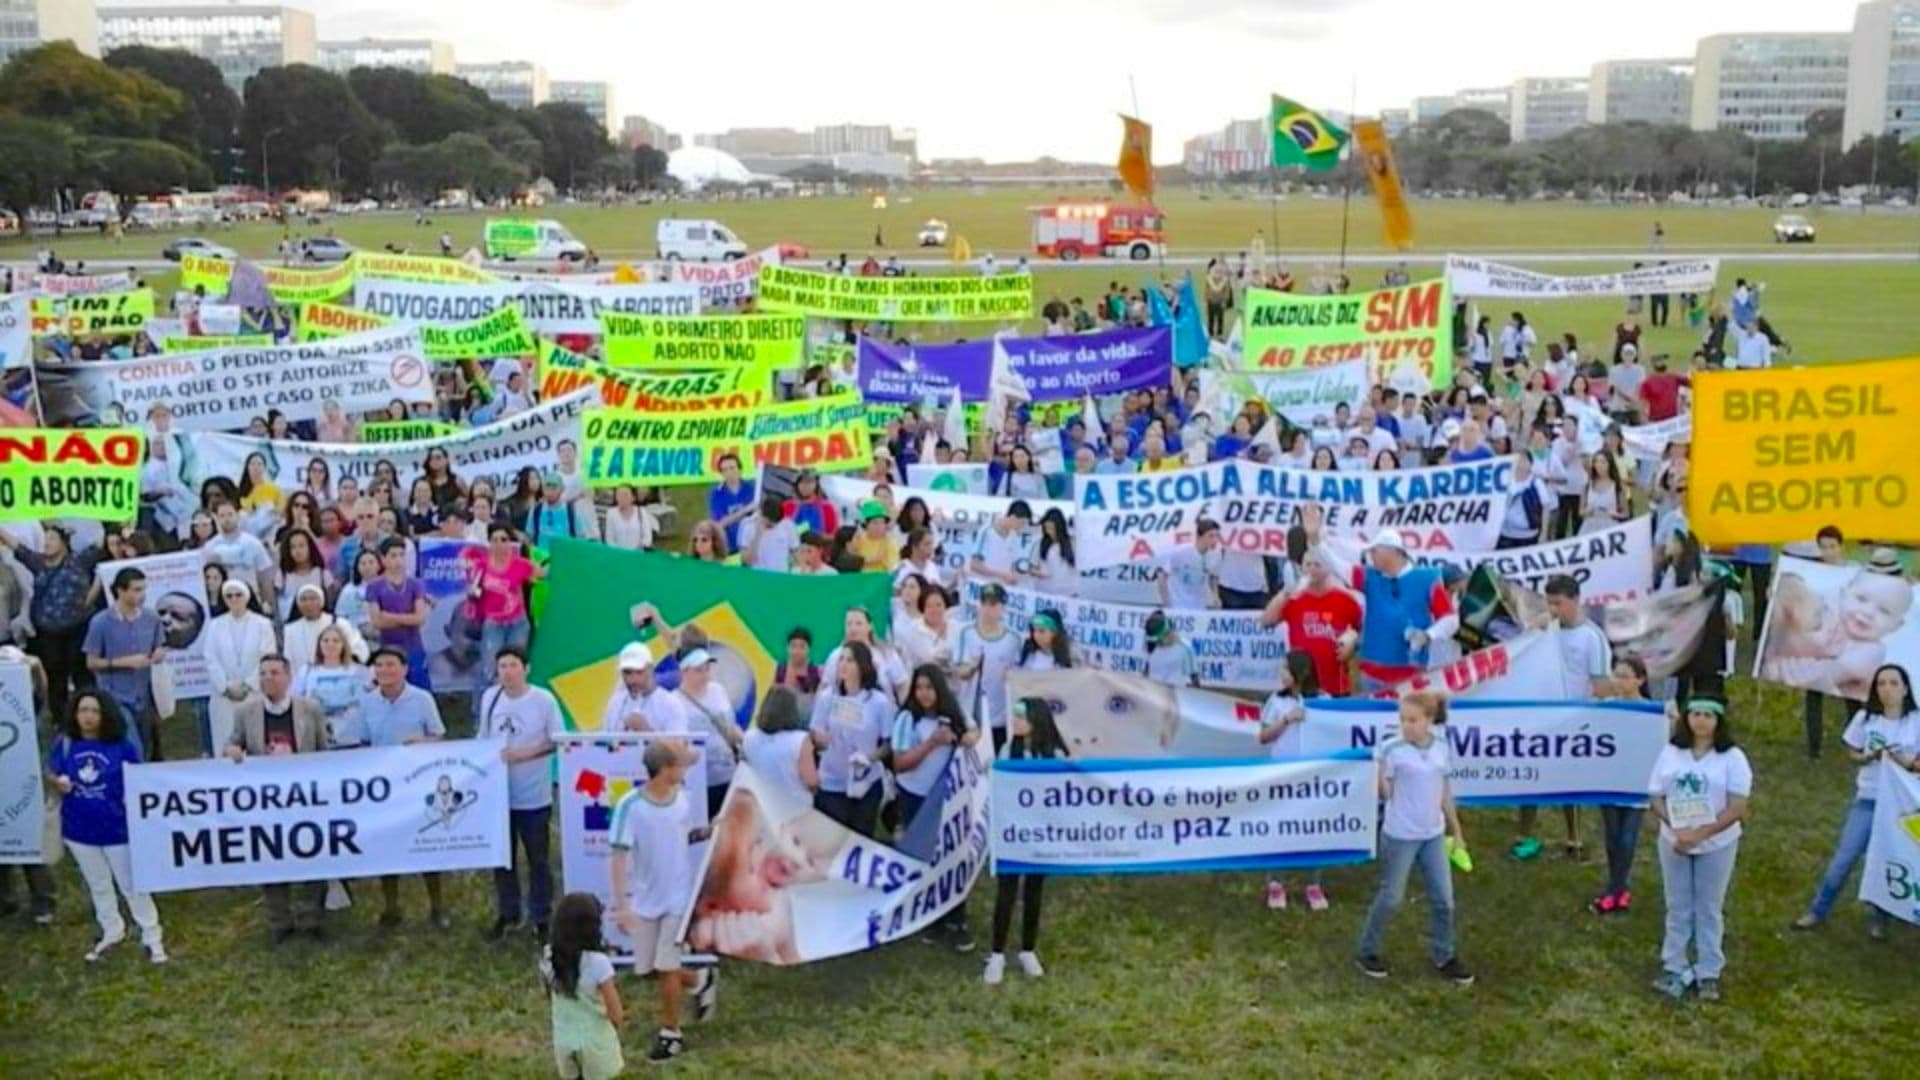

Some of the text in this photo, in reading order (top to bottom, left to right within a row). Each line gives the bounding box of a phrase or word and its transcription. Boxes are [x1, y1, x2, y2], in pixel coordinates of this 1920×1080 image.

[681, 262, 730, 283] VIDA
[775, 268, 827, 291] ABORTO
[364, 289, 495, 321] ADVOGADOS
[1336, 302, 1361, 325] DIZ
[455, 307, 519, 345] COVARDE
[653, 320, 665, 336] O
[669, 320, 744, 339] PRIMEIRO
[749, 319, 803, 340] DIREITO
[118, 358, 197, 383] CONTRA
[201, 355, 215, 373] O
[222, 346, 293, 369] PEDIDO
[655, 342, 720, 361] ABORTO
[1029, 349, 1070, 366] favor
[1075, 346, 1097, 363] da
[1259, 337, 1435, 367] AO ESTAUTO
[121, 359, 370, 404] PARA QUE O STF AUTORIZE
[1040, 376, 1060, 389] ao
[1064, 369, 1121, 388] Aborto
[125, 411, 138, 424] O
[228, 393, 258, 411] EM
[264, 386, 313, 407] CASO
[319, 383, 343, 402] DE
[350, 376, 392, 398] ZIKA
[1722, 383, 1898, 423] BRASIL
[586, 417, 603, 438] O
[606, 418, 674, 440] CENTRO
[455, 435, 551, 466] SENADO
[607, 448, 625, 476] A
[631, 446, 703, 477] FAVOR
[754, 428, 864, 467] VIDA!
[1754, 429, 1856, 467] SEM
[30, 476, 134, 512] ABORTO!
[1081, 460, 1513, 511] A ESCOLA ALLAN KARDEC
[1709, 474, 1909, 514] ABORTO
[1103, 507, 1185, 537] APOIA
[1224, 500, 1342, 527] DEFENE
[1352, 508, 1369, 527] A
[1379, 499, 1491, 527] MARCHA
[1078, 604, 1108, 623] SÃO
[1191, 638, 1243, 657] NOSSA
[1443, 645, 1510, 693] UM
[1446, 721, 1618, 758] Matarás
[1485, 764, 1540, 782] 20:13)
[139, 775, 392, 819] PASTORAL DO
[1018, 775, 1351, 809] o aborto é hoje o maior
[171, 817, 363, 868] MENOR
[1003, 812, 1367, 846] destruidor da paz no mundo.
[843, 845, 864, 884] A
[887, 903, 904, 936] A
